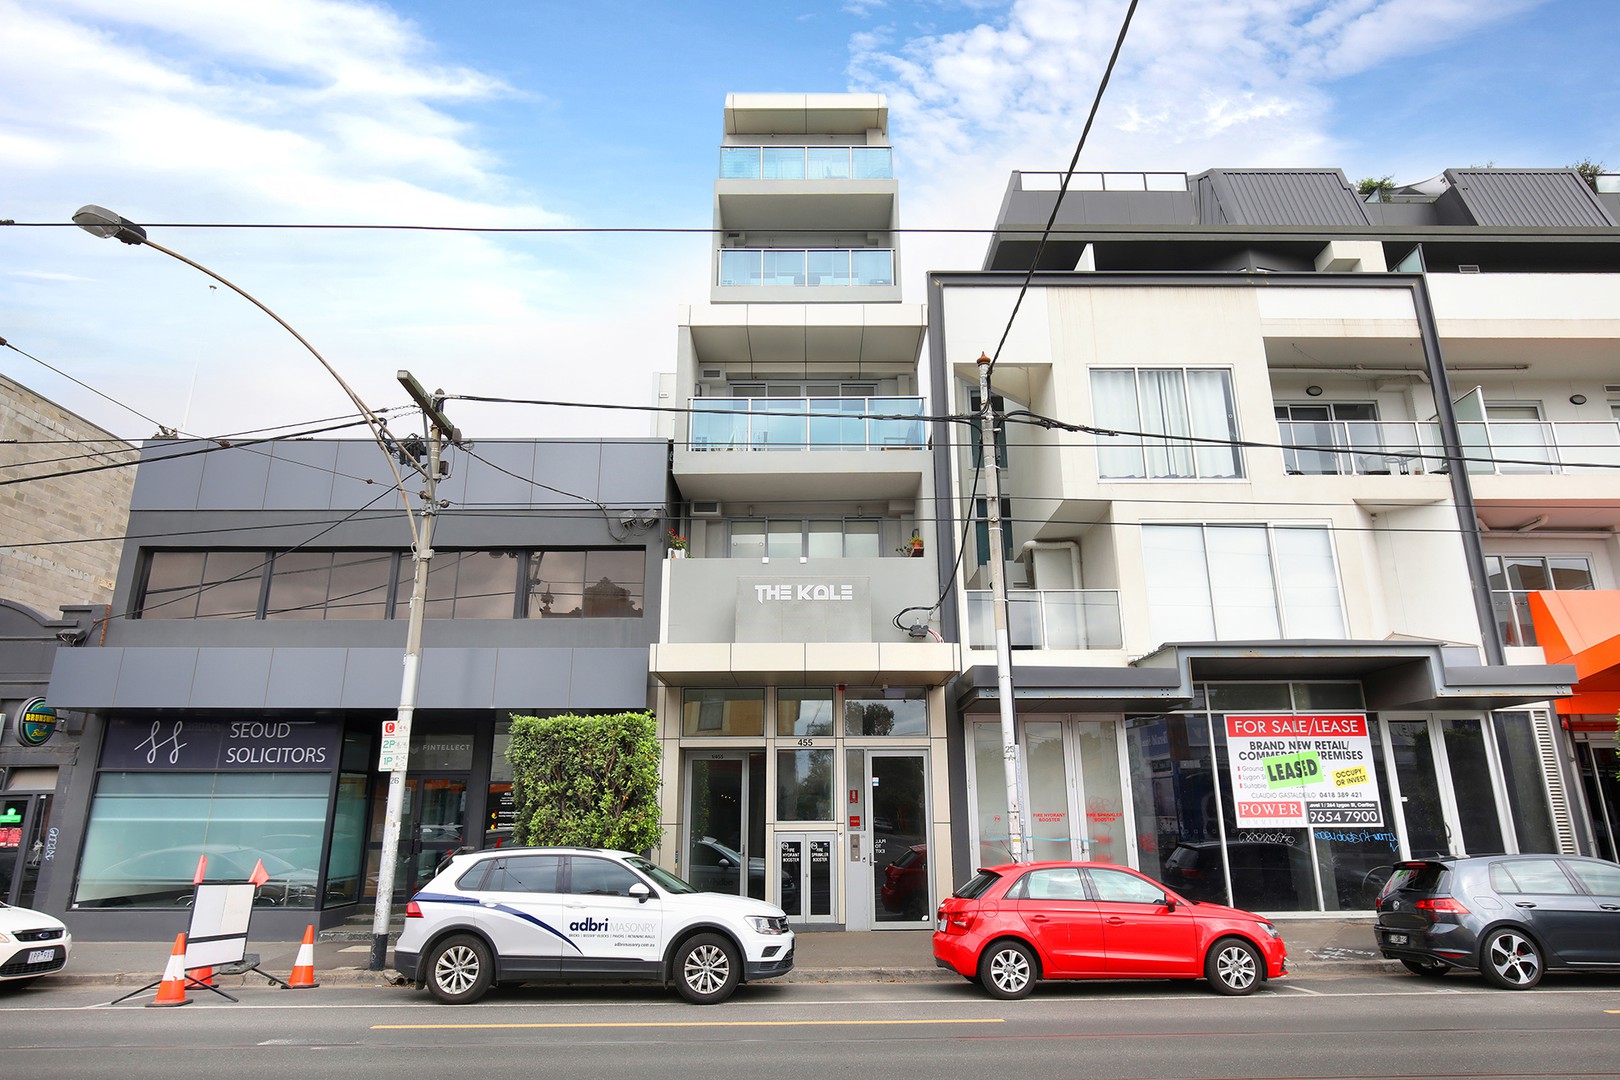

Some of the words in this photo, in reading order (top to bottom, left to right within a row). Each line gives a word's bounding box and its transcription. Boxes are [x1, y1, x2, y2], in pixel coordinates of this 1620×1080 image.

[754, 584, 792, 604] THE
[797, 584, 853, 601] KOLE
[229, 722, 291, 738] SEOUD
[1234, 720, 1267, 734] FOR
[1271, 717, 1359, 736] SALE/LEASE
[383, 740, 396, 749] 2P
[797, 739, 813, 747] 455
[1249, 741, 1286, 751] BRAND
[1288, 741, 1311, 750] NEW
[225, 747, 326, 763] SOLICITORS
[1004, 745, 1015, 754] 25
[383, 757, 393, 766] 1P
[1238, 751, 1300, 761] COMME
[1266, 758, 1318, 782] LEASED
[1335, 768, 1362, 779] OCCUPY
[390, 777, 400, 785] 26
[1335, 779, 1346, 787] OR
[1347, 775, 1367, 784] INVEST
[1240, 803, 1300, 816] POWER
[1309, 811, 1342, 823] 9654
[1344, 810, 1378, 822] 7900
[569, 917, 609, 932] adbri
[610, 922, 656, 933] MASONRY
